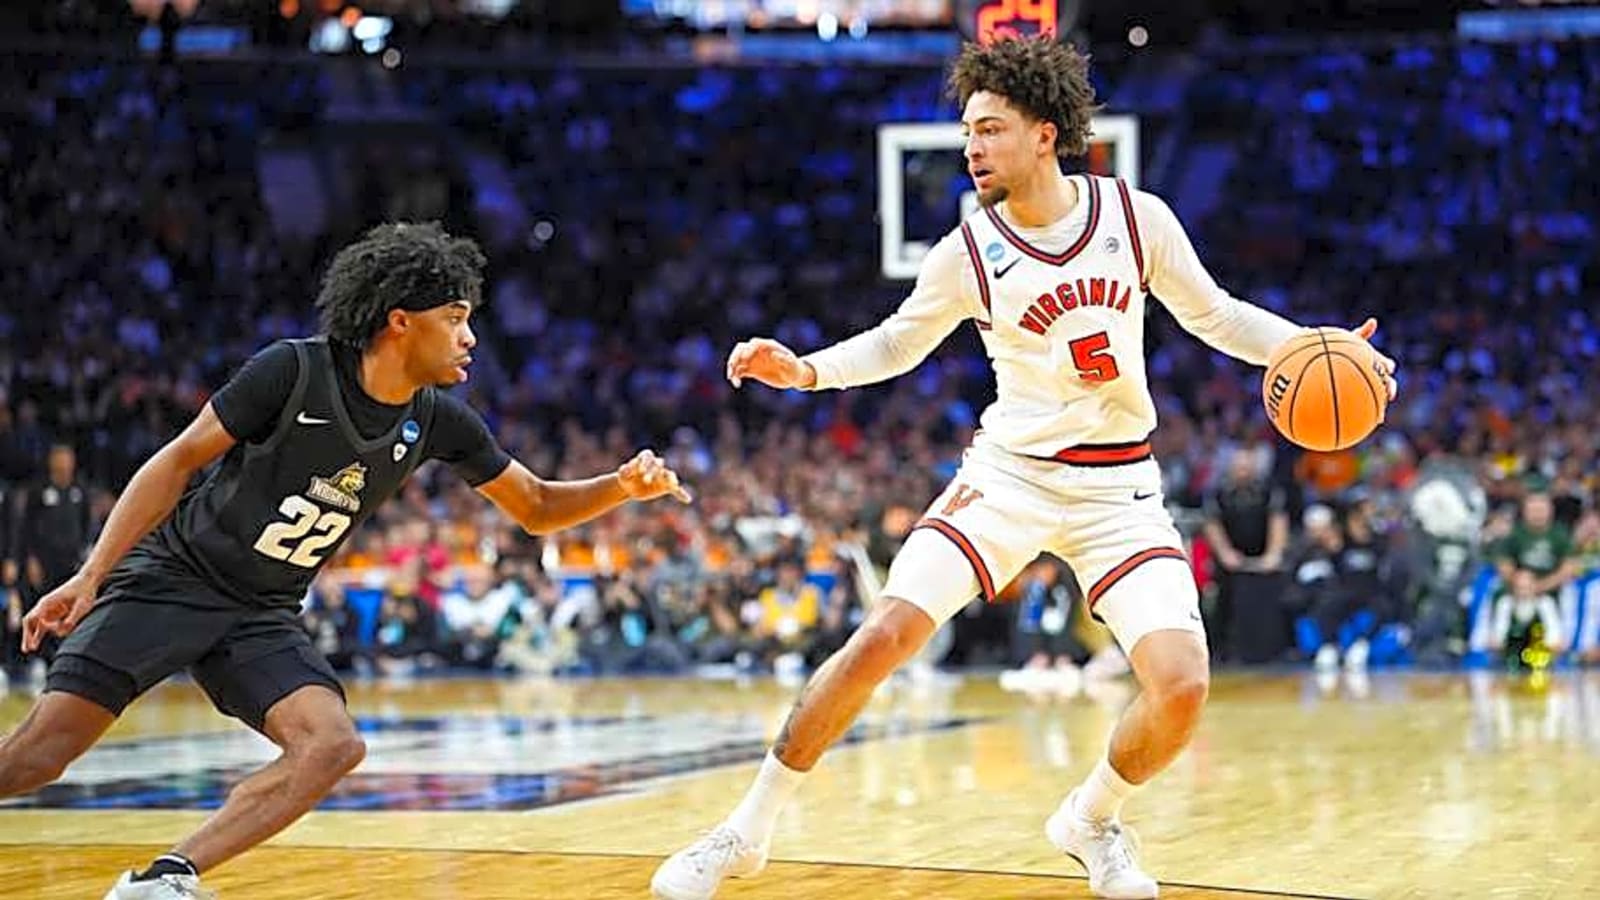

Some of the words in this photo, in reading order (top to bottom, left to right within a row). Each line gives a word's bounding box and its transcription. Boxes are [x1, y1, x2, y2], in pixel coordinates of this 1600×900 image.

[1018, 278, 1131, 336] VIRGINIA
[1067, 331, 1120, 382] 5
[253, 495, 351, 568] 22
